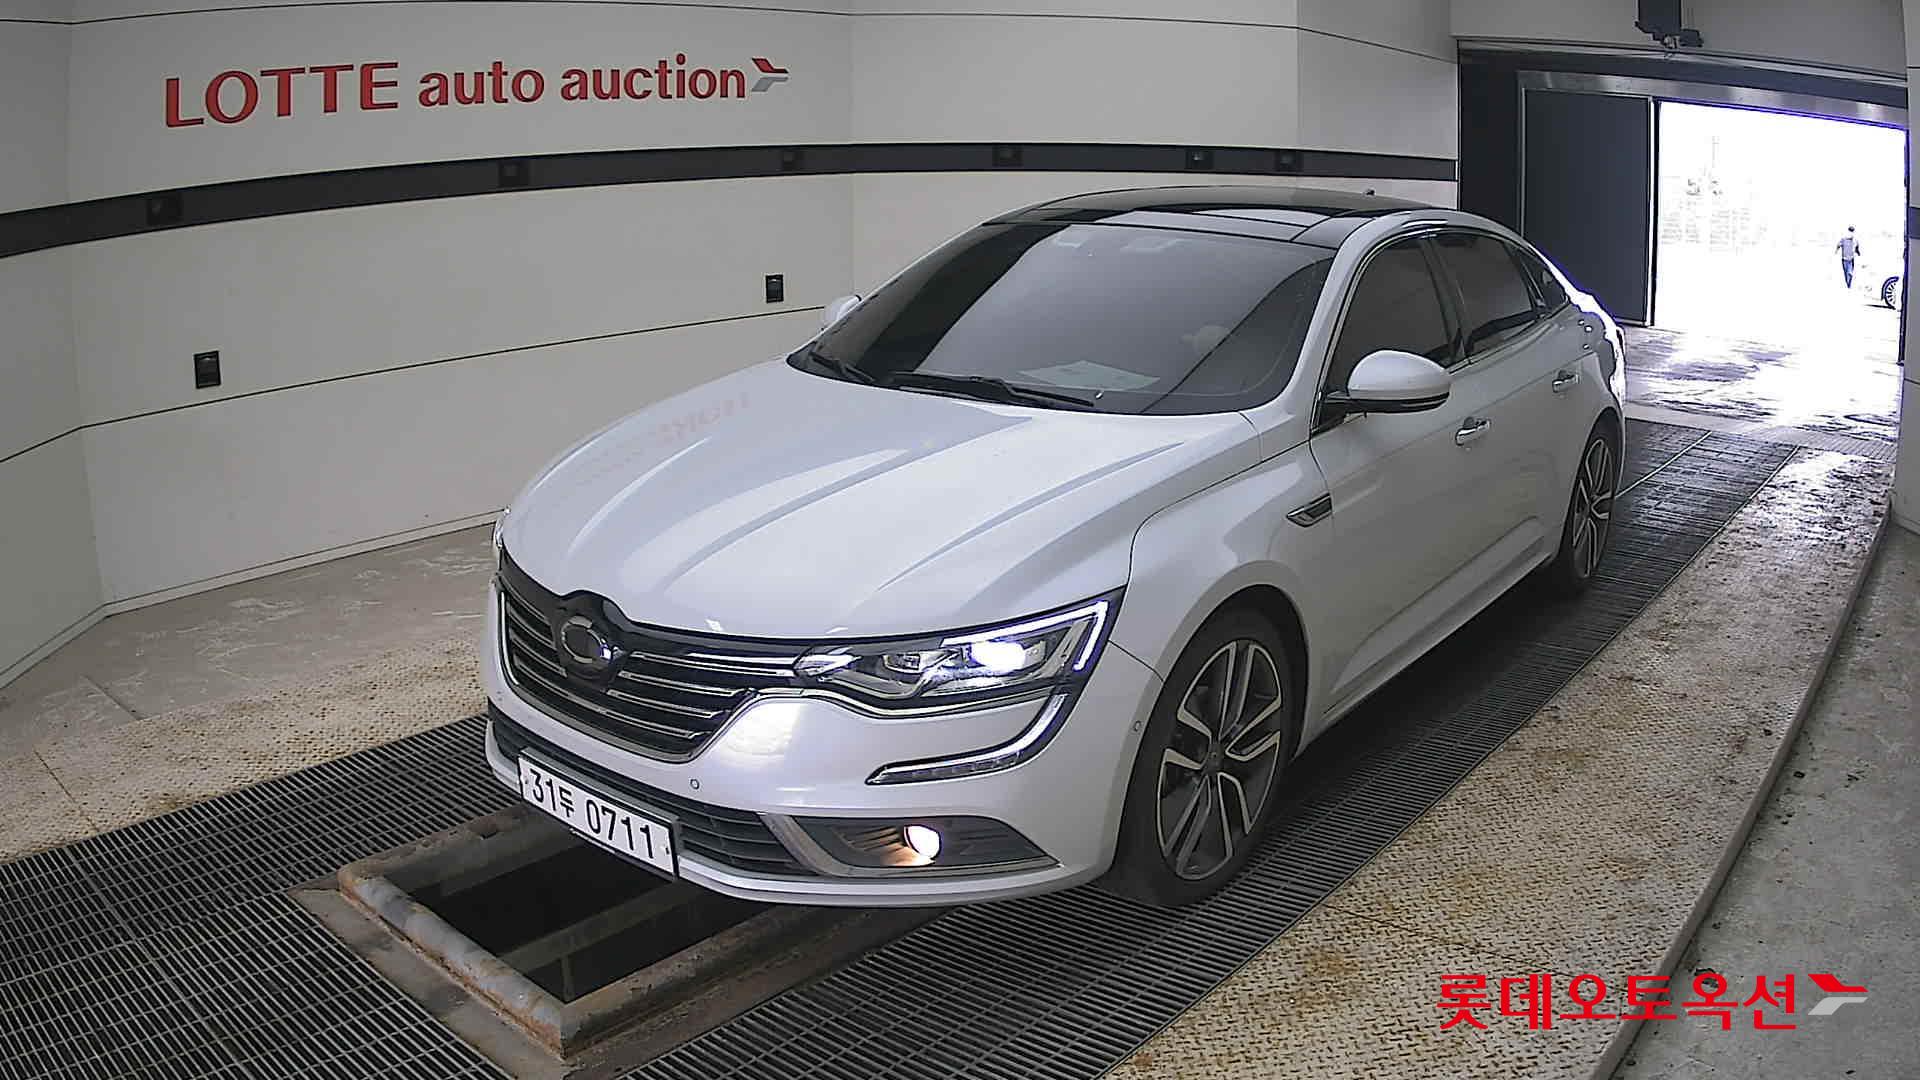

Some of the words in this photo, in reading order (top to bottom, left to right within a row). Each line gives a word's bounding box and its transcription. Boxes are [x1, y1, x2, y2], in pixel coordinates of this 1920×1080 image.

[165, 62, 399, 128] LOTTE
[418, 61, 545, 107] auto
[560, 52, 746, 101] auction
[529, 768, 575, 818] 31두
[586, 799, 654, 859] 0711
